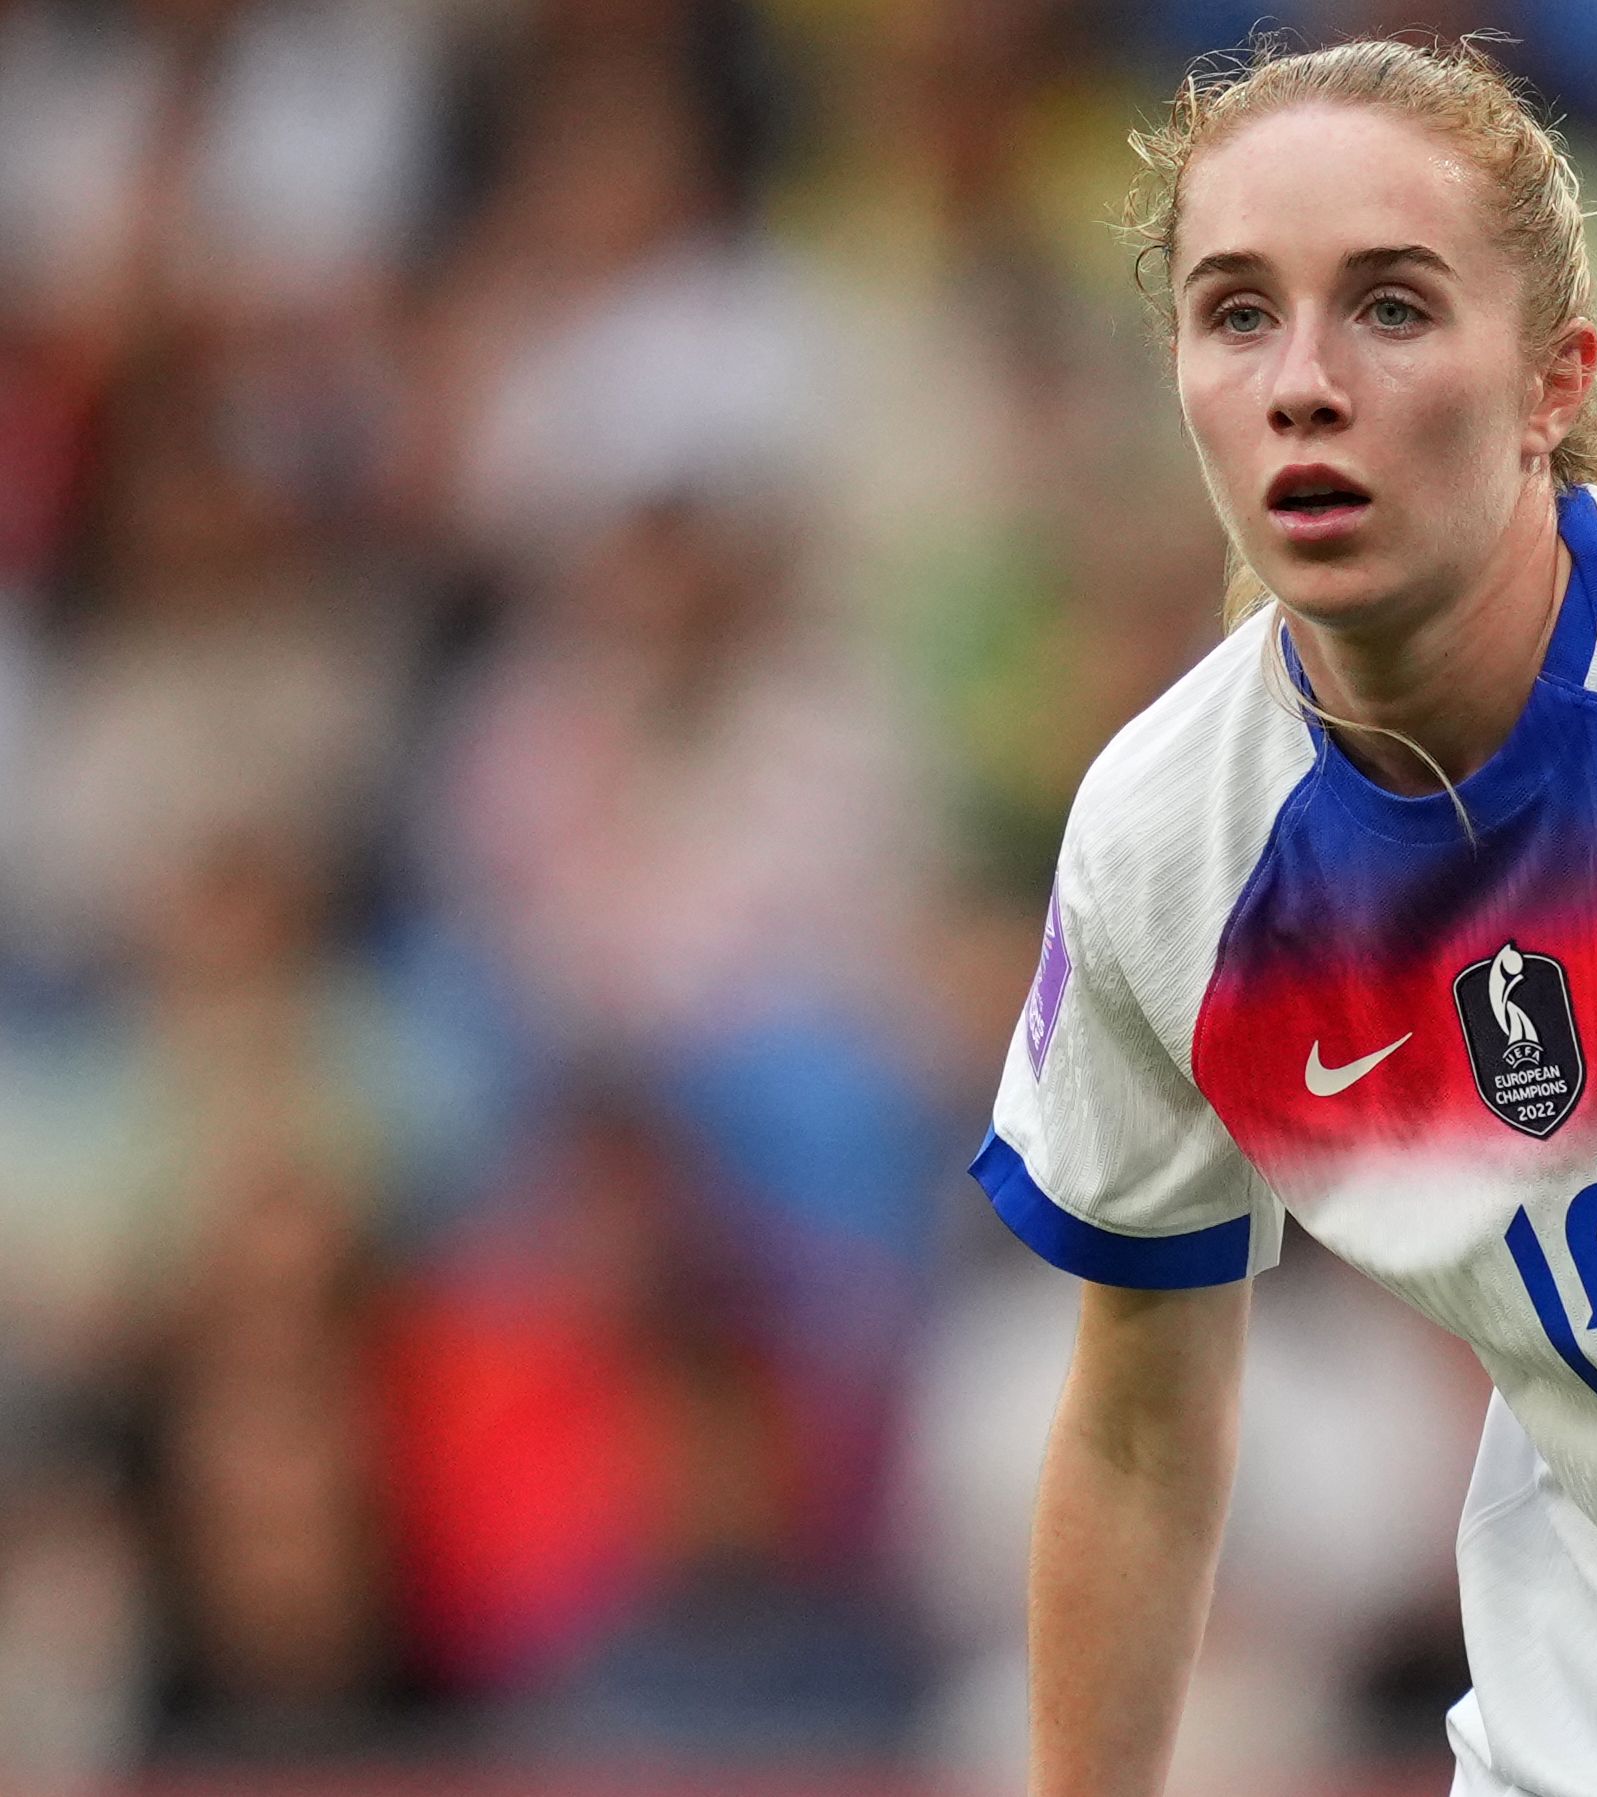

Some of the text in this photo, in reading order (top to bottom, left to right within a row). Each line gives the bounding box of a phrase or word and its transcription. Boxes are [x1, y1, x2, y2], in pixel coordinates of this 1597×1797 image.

[1505, 1048, 1541, 1066] UEFA
[1494, 1065, 1561, 1089] EUROPEAN
[1495, 1080, 1568, 1105] CHAMPIONS
[1517, 1101, 1556, 1122] 2022
